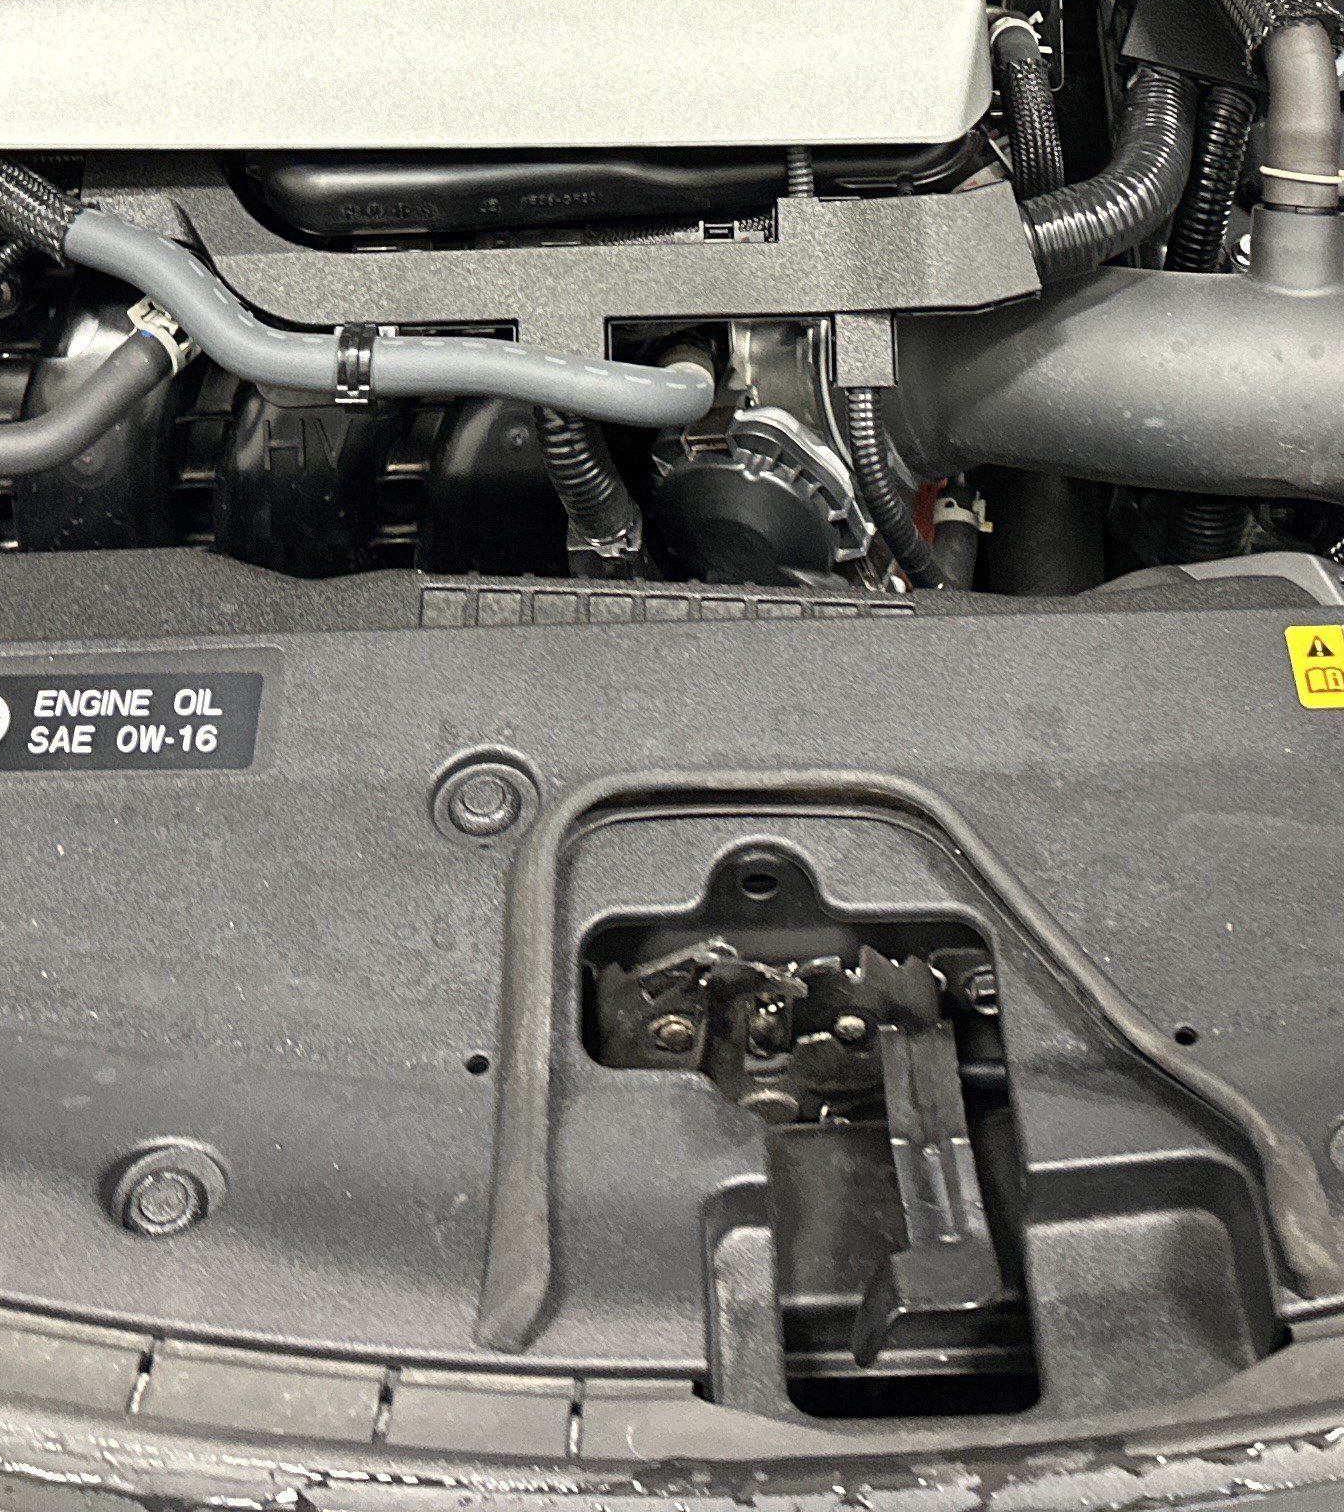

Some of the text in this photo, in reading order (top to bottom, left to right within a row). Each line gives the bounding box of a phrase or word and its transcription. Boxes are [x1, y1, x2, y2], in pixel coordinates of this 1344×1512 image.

[262, 418, 354, 471] HV
[33, 687, 223, 718] ENGINE OIL
[26, 724, 219, 755] SAE 0W-16
